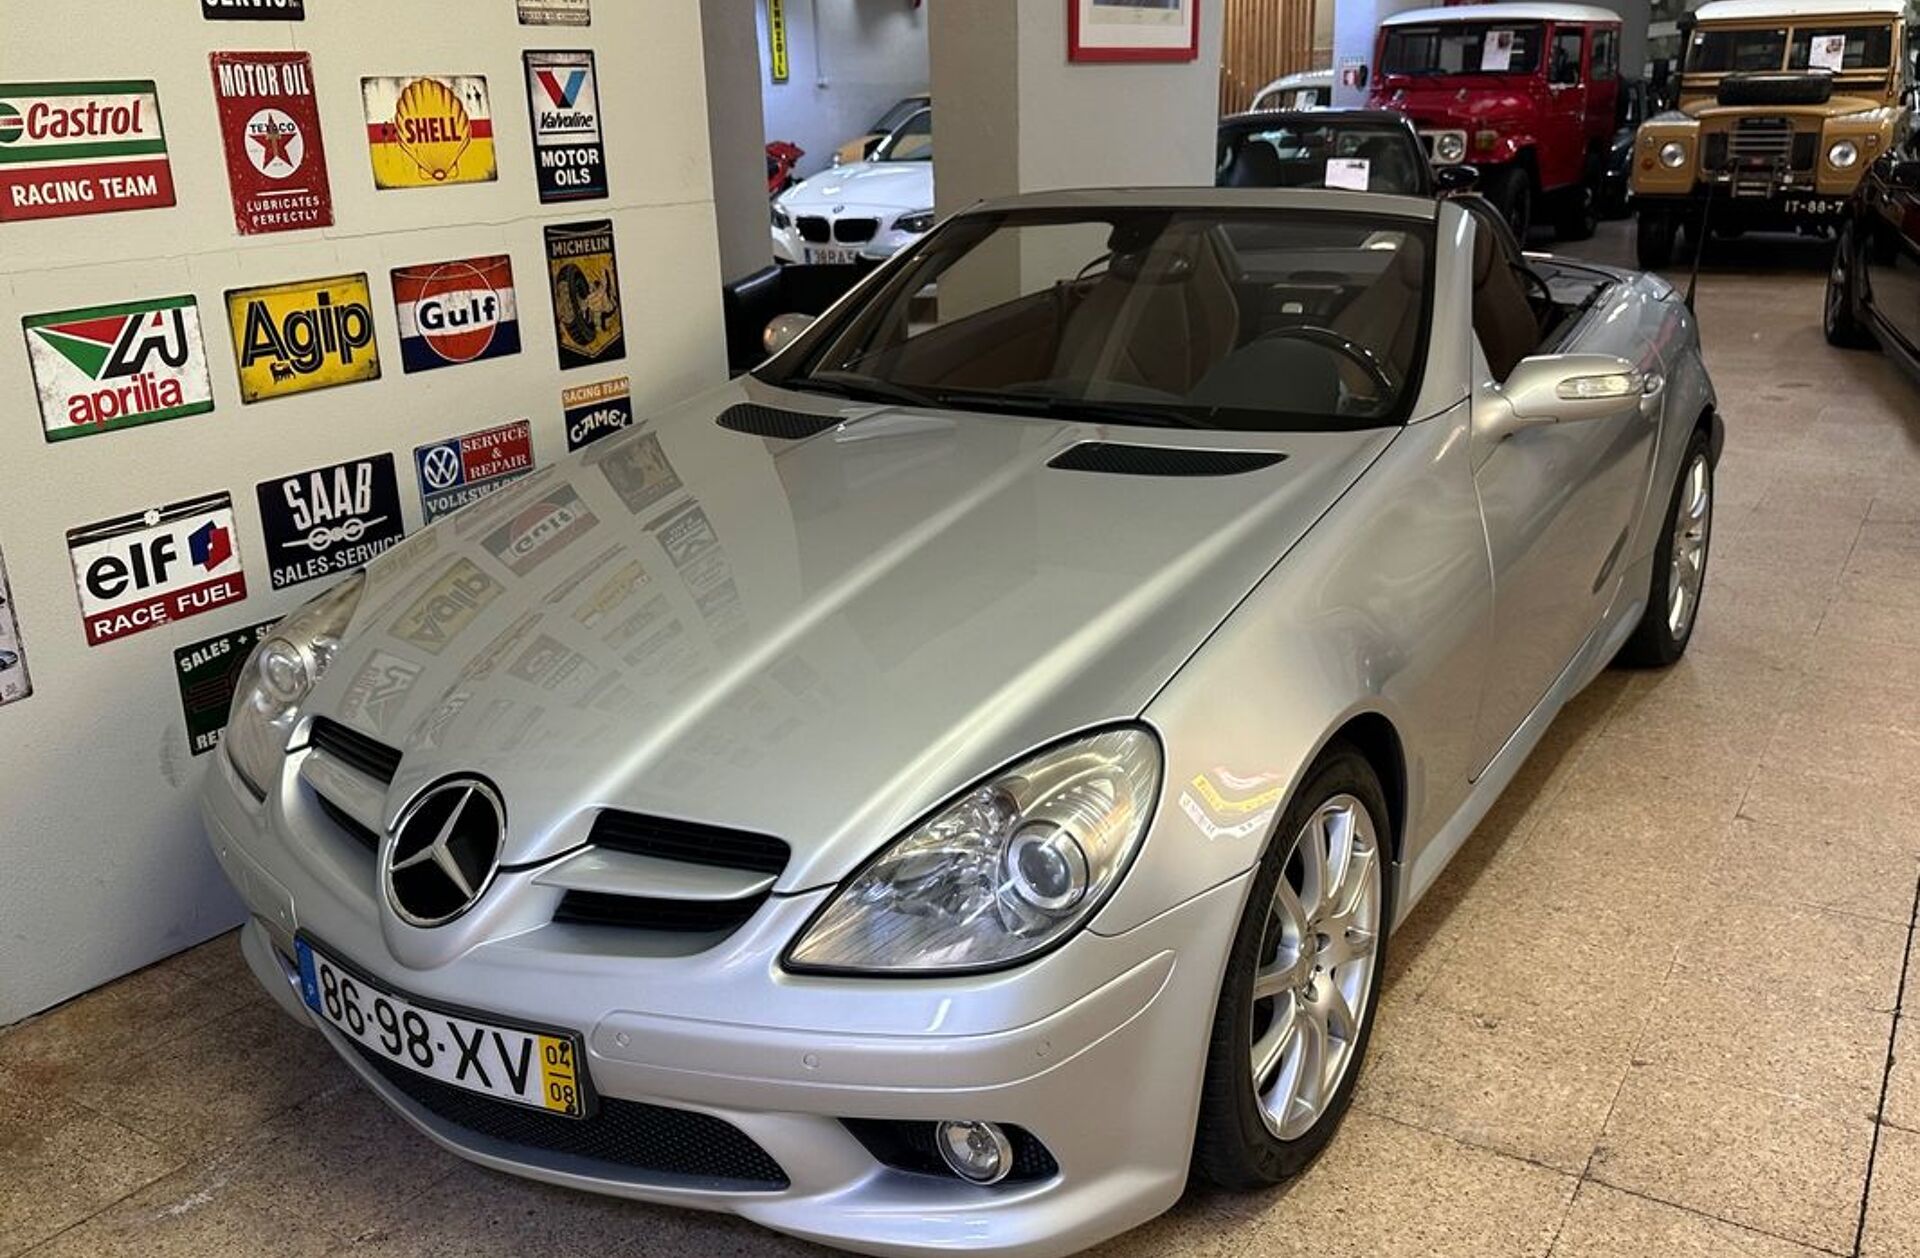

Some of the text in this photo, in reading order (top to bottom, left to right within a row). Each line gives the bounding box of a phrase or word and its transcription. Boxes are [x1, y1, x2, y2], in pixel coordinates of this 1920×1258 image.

[218, 64, 310, 97] MOTOR OIL
[27, 100, 143, 140] Castrol
[250, 122, 296, 133] TEXACO
[405, 116, 461, 143] SHELL
[541, 112, 593, 129] Valvoline
[541, 148, 600, 168] MOTOR
[11, 175, 158, 207] RACING TEAM
[555, 168, 591, 186] OILS
[247, 196, 320, 212] LUBRICATES
[252, 209, 318, 227] PERFECTLY
[551, 236, 610, 256] MICHELIN
[419, 296, 496, 329] Gulf
[241, 291, 372, 373] Agip
[68, 372, 183, 430] aprilia
[563, 379, 630, 403] RACING TEAM
[461, 424, 529, 453] SERVICE
[570, 409, 628, 443] CAMEL
[470, 453, 528, 479] REPAIR
[490, 446, 503, 460] &
[282, 462, 373, 531] SAAB
[86, 533, 178, 600] elf
[94, 582, 240, 638] RACE FUEL
[180, 638, 231, 672] SALES
